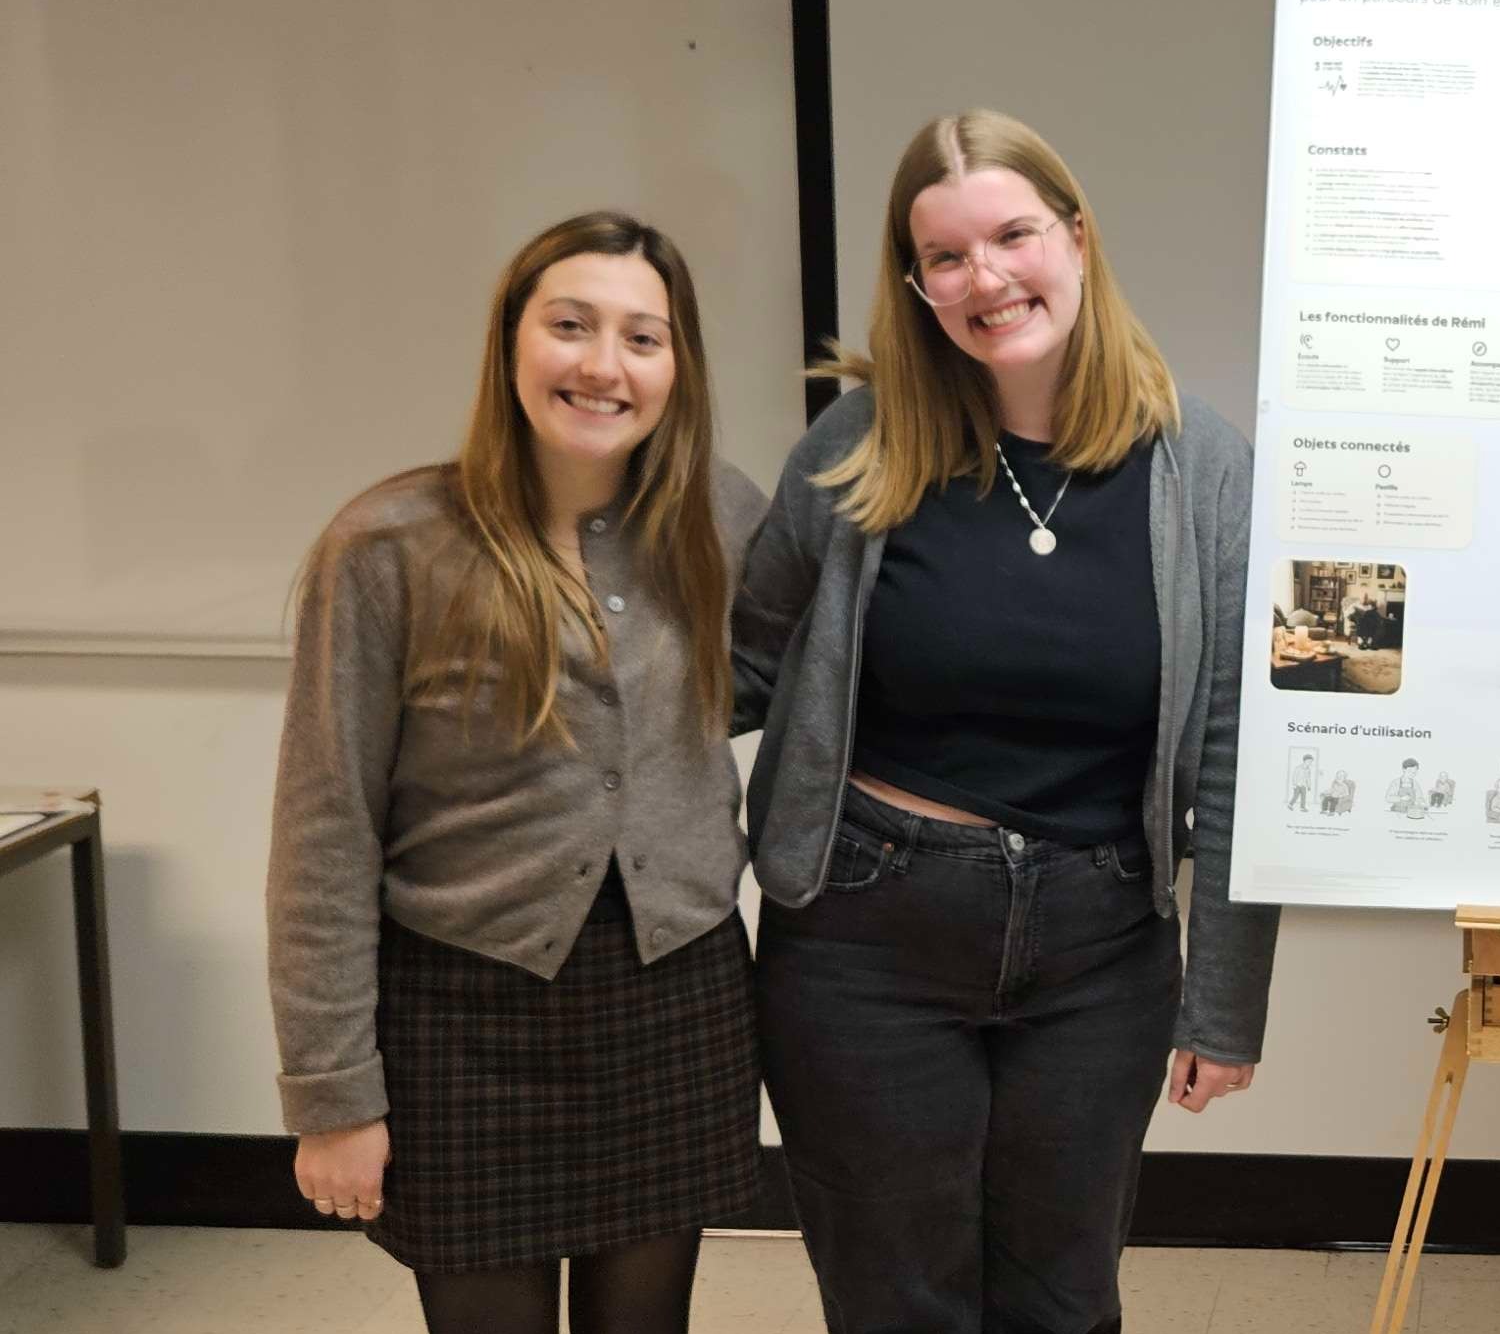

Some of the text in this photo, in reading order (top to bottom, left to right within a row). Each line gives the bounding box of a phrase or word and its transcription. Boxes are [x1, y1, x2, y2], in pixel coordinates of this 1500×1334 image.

[1312, 35, 1373, 49] Objectifs
[1307, 144, 1367, 156] Constats
[1299, 311, 1486, 329] Les fonctionnalités de Rémi
[1292, 437, 1411, 453] Objets connectés
[1287, 721, 1347, 735] Scénario
